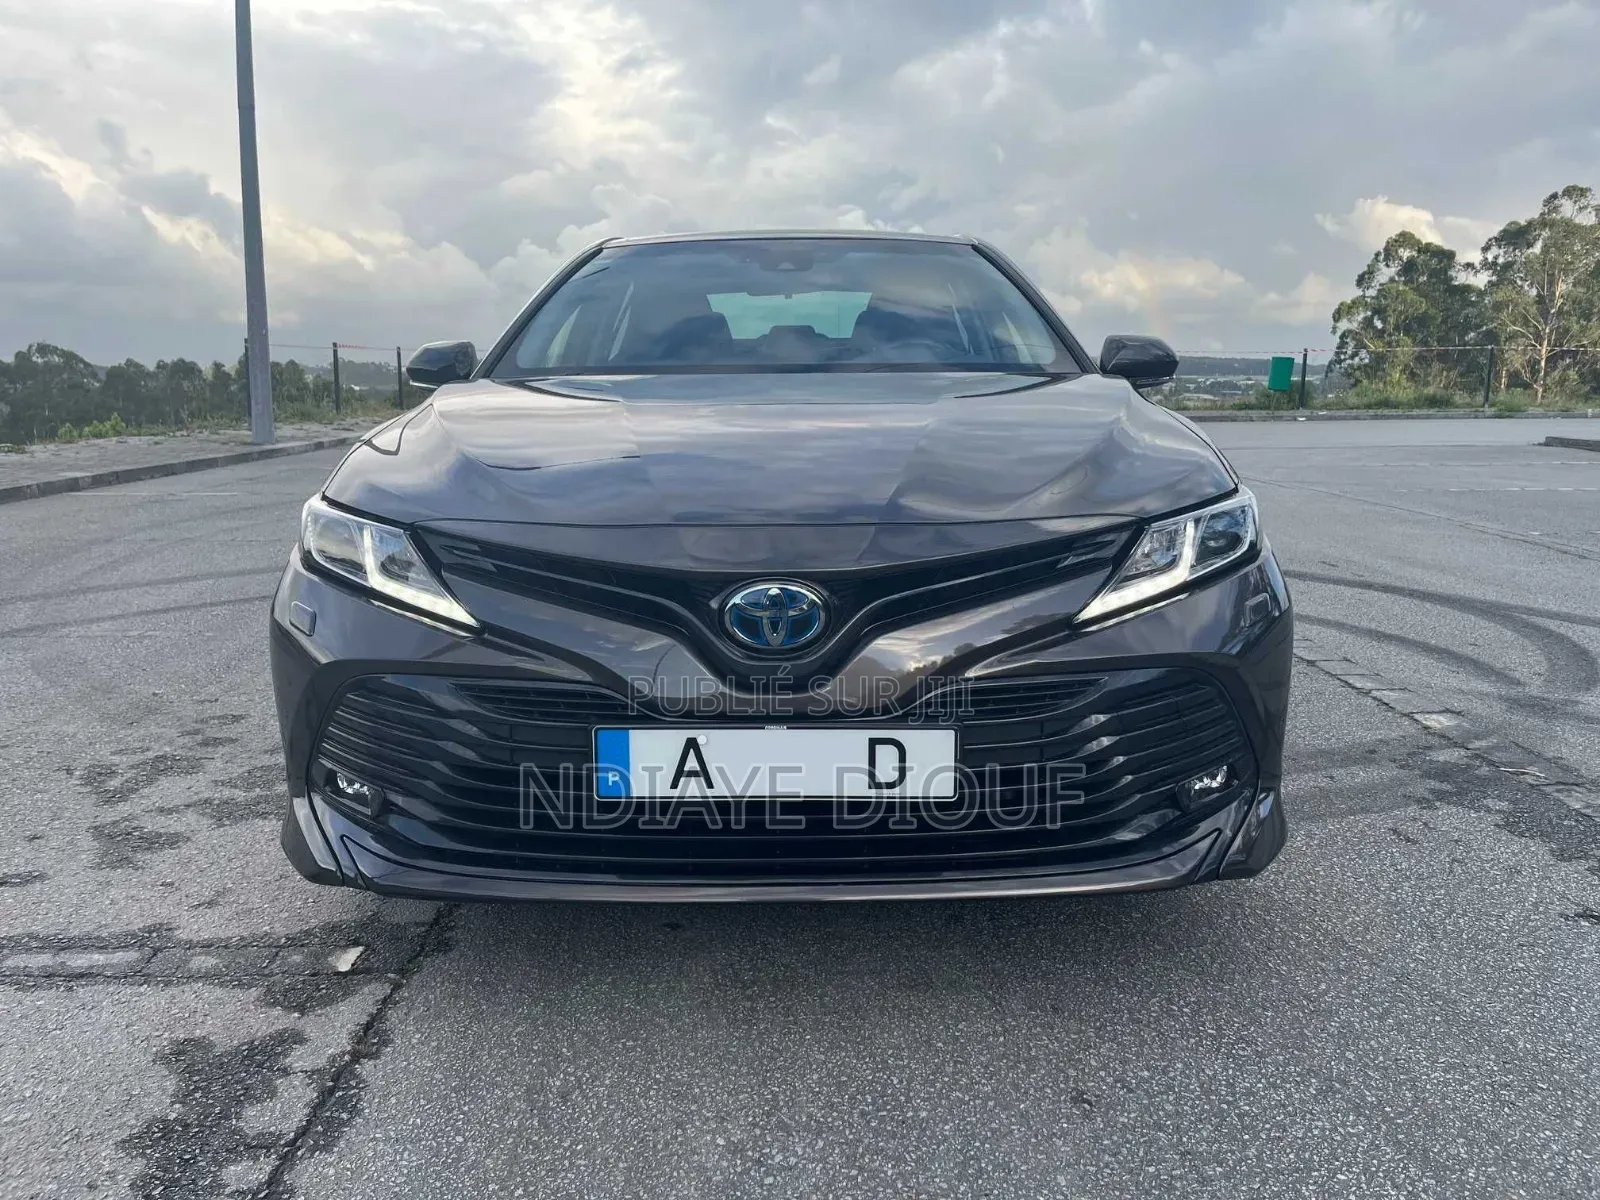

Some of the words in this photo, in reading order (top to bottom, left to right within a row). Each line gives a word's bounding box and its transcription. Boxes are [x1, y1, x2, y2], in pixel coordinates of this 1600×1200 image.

[608, 771, 620, 787] P
[669, 737, 715, 790] A
[867, 737, 907, 790] D
